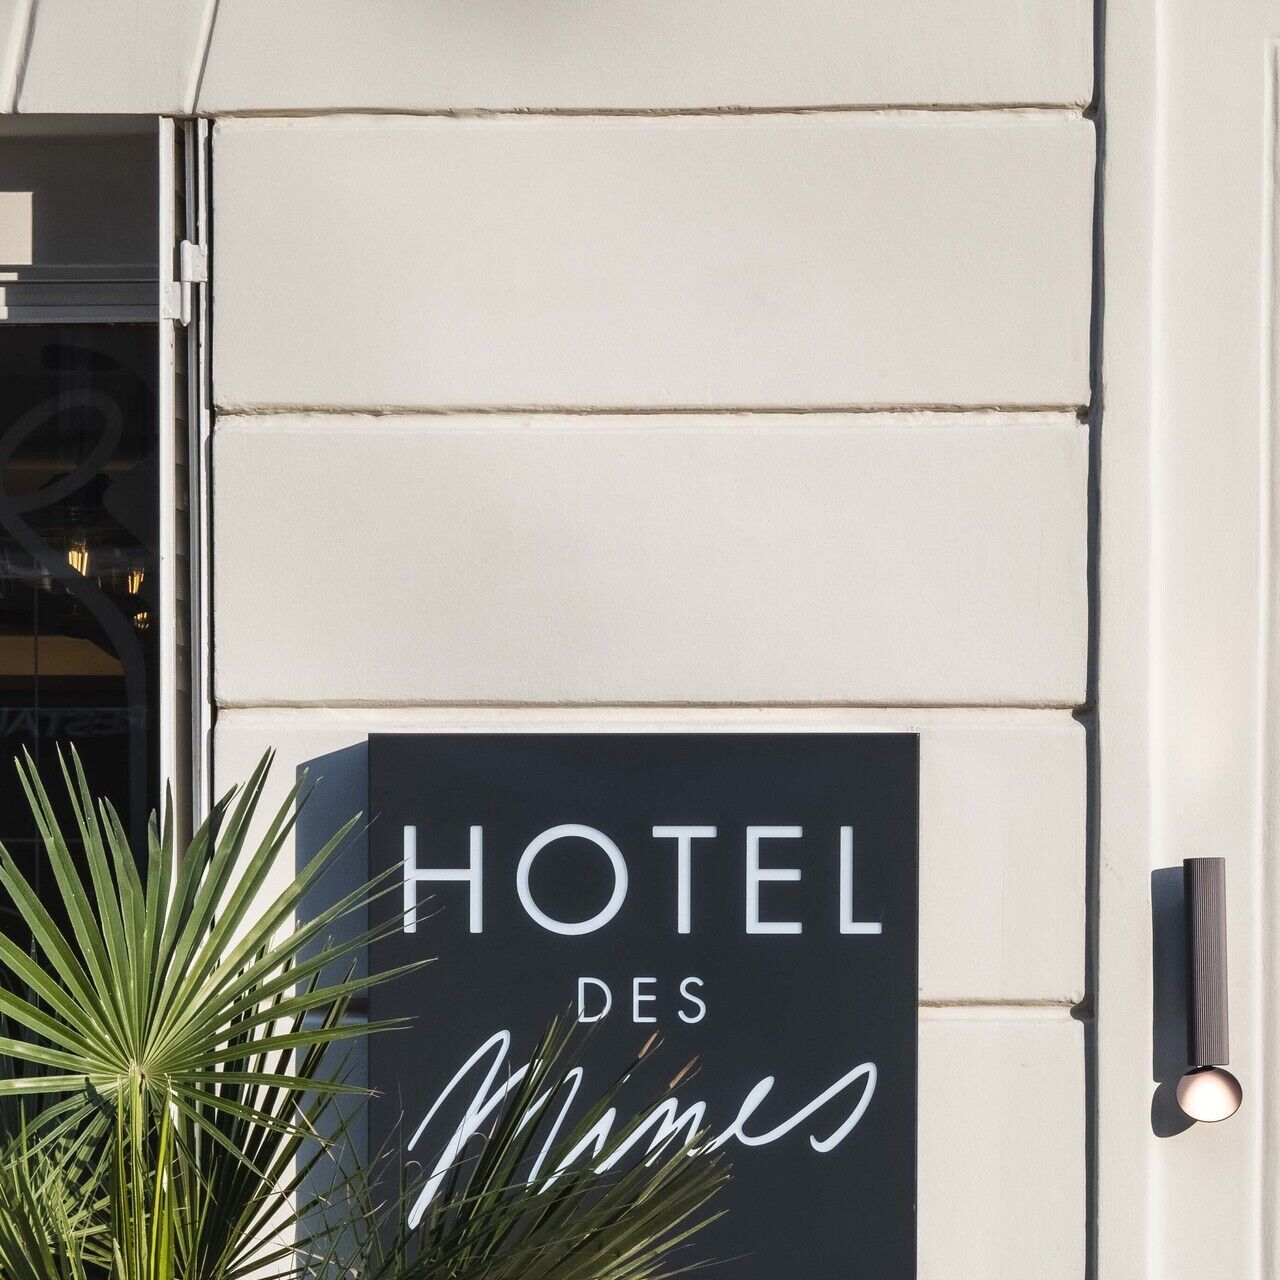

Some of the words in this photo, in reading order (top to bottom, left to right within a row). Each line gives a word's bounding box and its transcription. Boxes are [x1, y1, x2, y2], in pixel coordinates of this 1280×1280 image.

[403, 823, 882, 935] HOTEL
[578, 976, 707, 1023] DES
[407, 1029, 878, 1230] Mines
